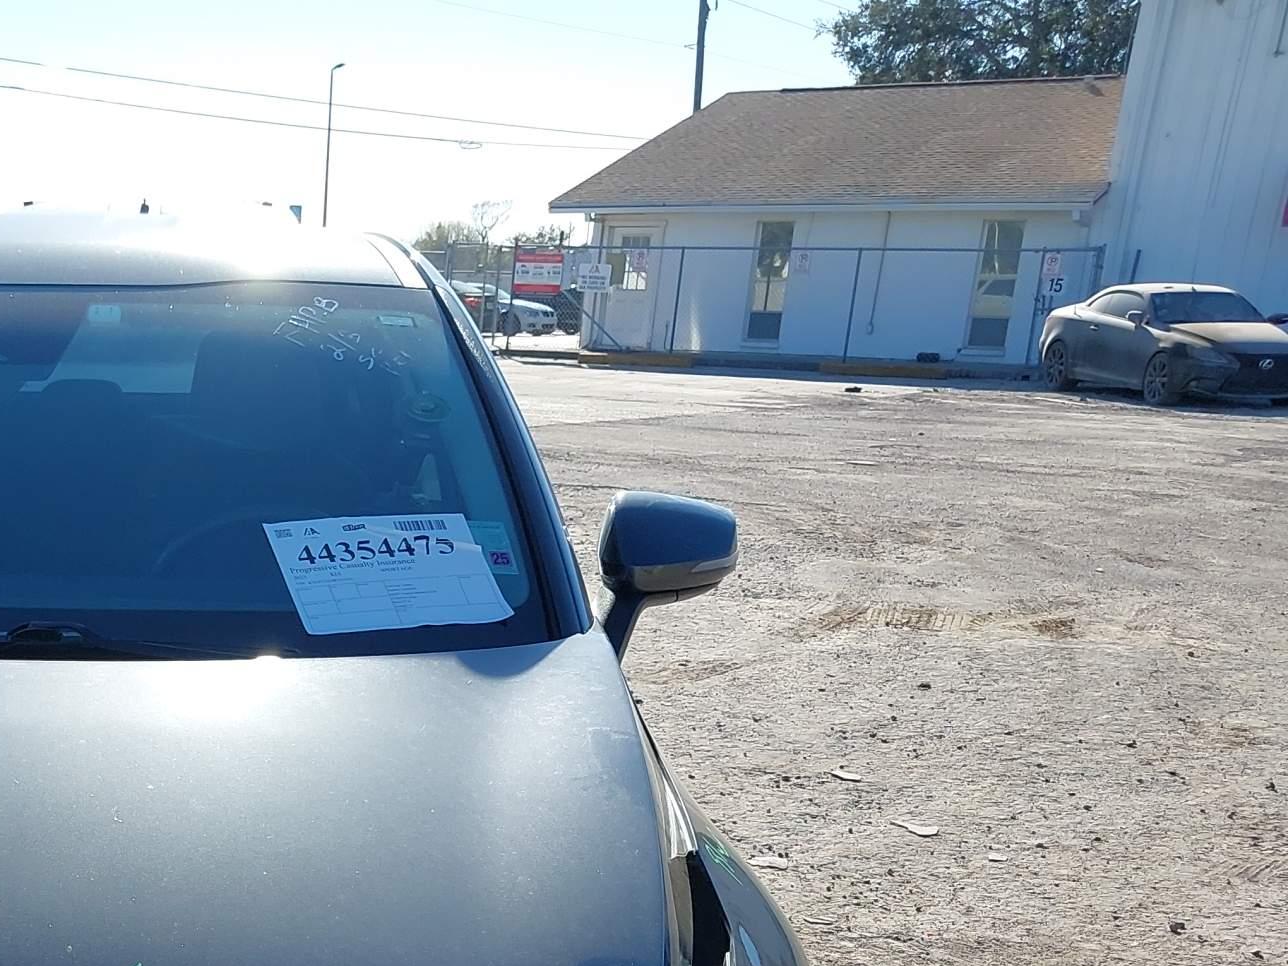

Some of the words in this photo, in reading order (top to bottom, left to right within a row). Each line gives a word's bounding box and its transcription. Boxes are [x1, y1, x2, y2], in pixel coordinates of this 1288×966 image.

[1048, 278, 1064, 293] 15
[298, 535, 455, 565] 44354475
[289, 563, 337, 575] Progressive
[338, 560, 374, 570] Casualty
[376, 558, 416, 567] Insurance
[491, 552, 510, 566] 25
